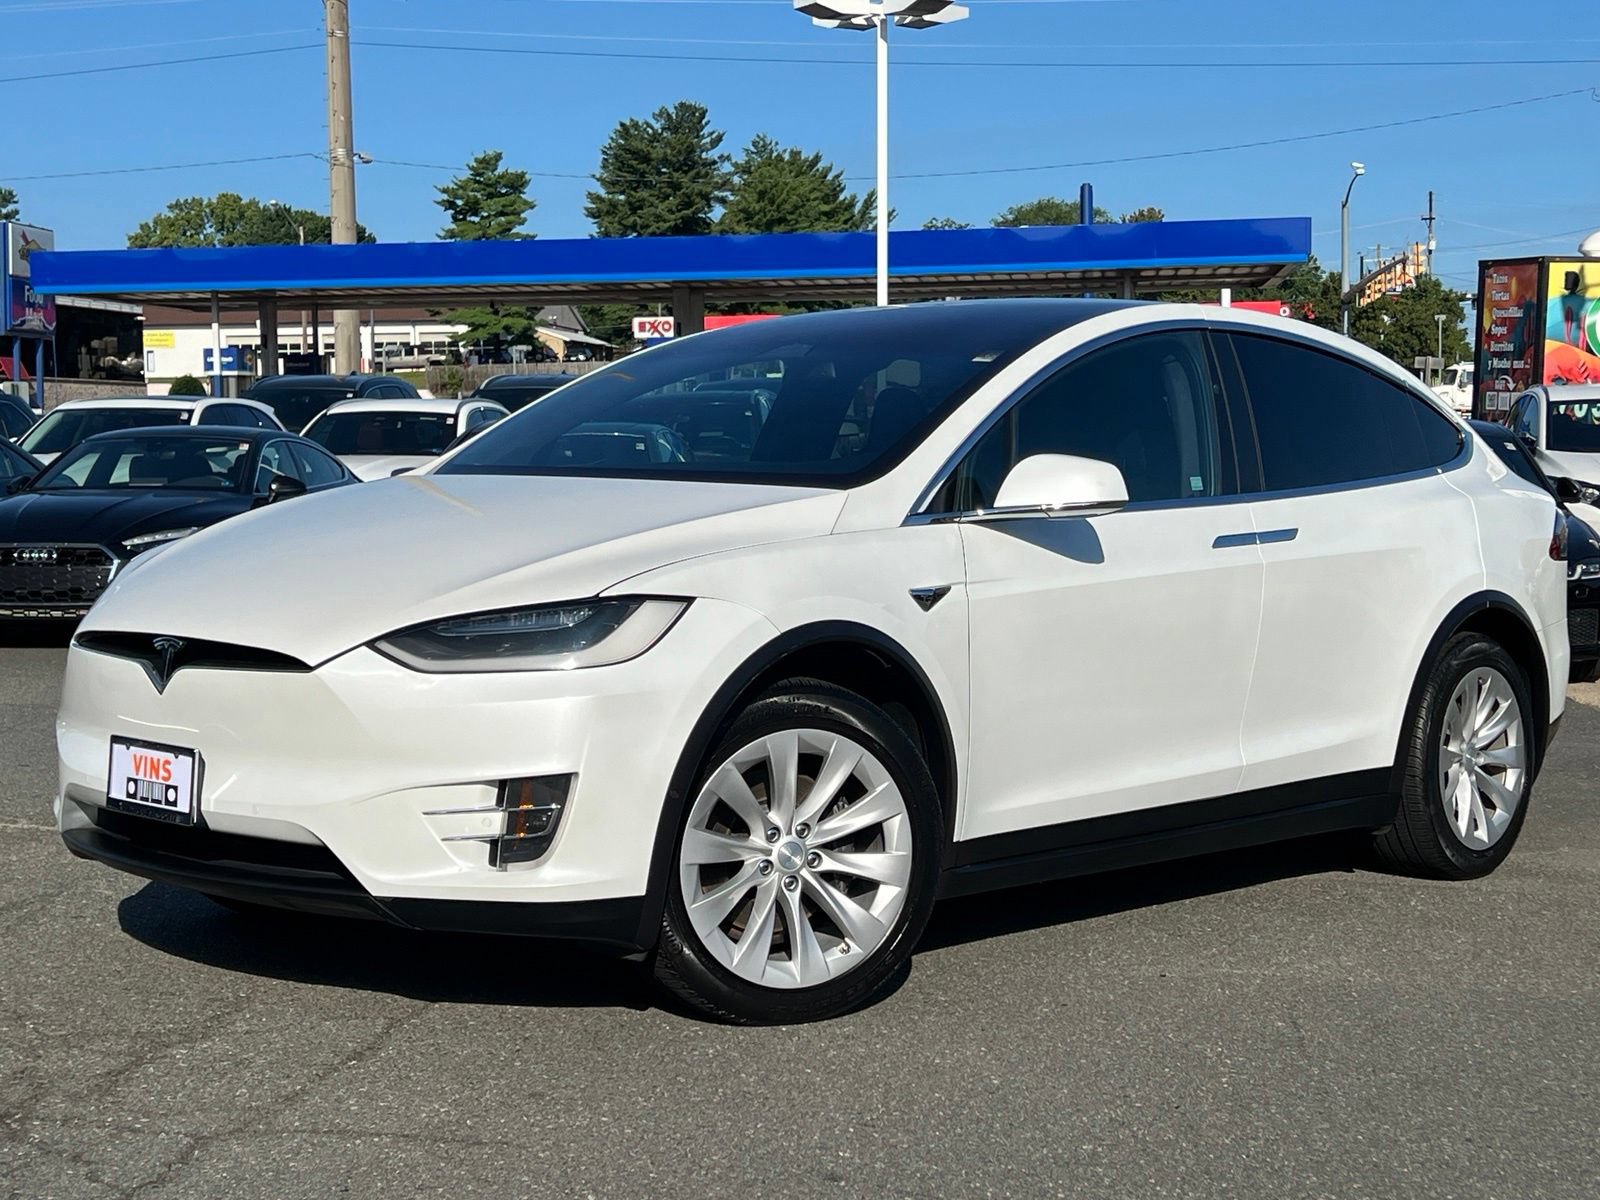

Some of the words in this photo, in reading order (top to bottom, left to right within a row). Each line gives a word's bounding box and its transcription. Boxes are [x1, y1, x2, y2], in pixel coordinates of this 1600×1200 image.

[1492, 290, 1510, 301] Tortas
[1490, 341, 1514, 352] Burritos
[133, 753, 172, 782] VINS
